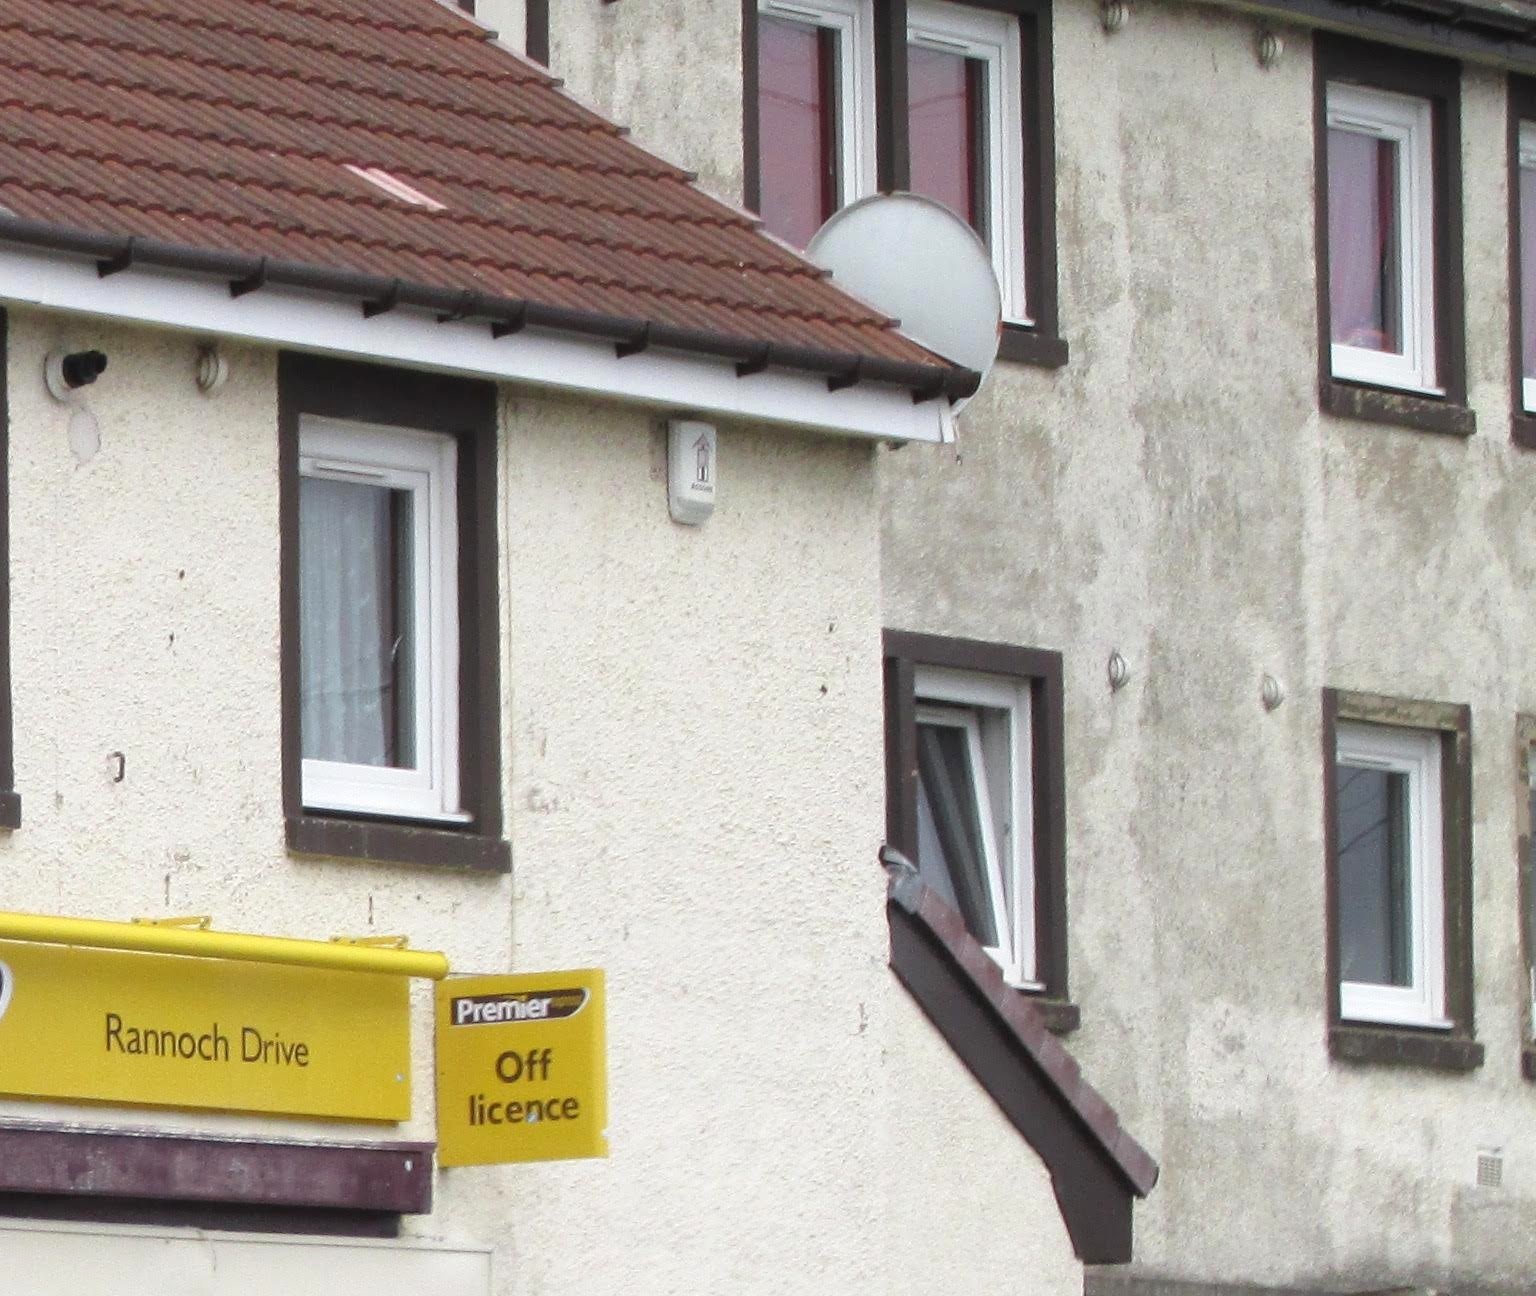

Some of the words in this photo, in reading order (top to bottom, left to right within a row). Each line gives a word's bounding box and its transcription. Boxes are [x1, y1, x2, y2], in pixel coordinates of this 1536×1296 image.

[456, 996, 553, 1024] Premier
[106, 1012, 229, 1062] Rannoch
[241, 1026, 309, 1067] Drive
[495, 1048, 553, 1084] Off
[469, 1093, 580, 1126] licence
